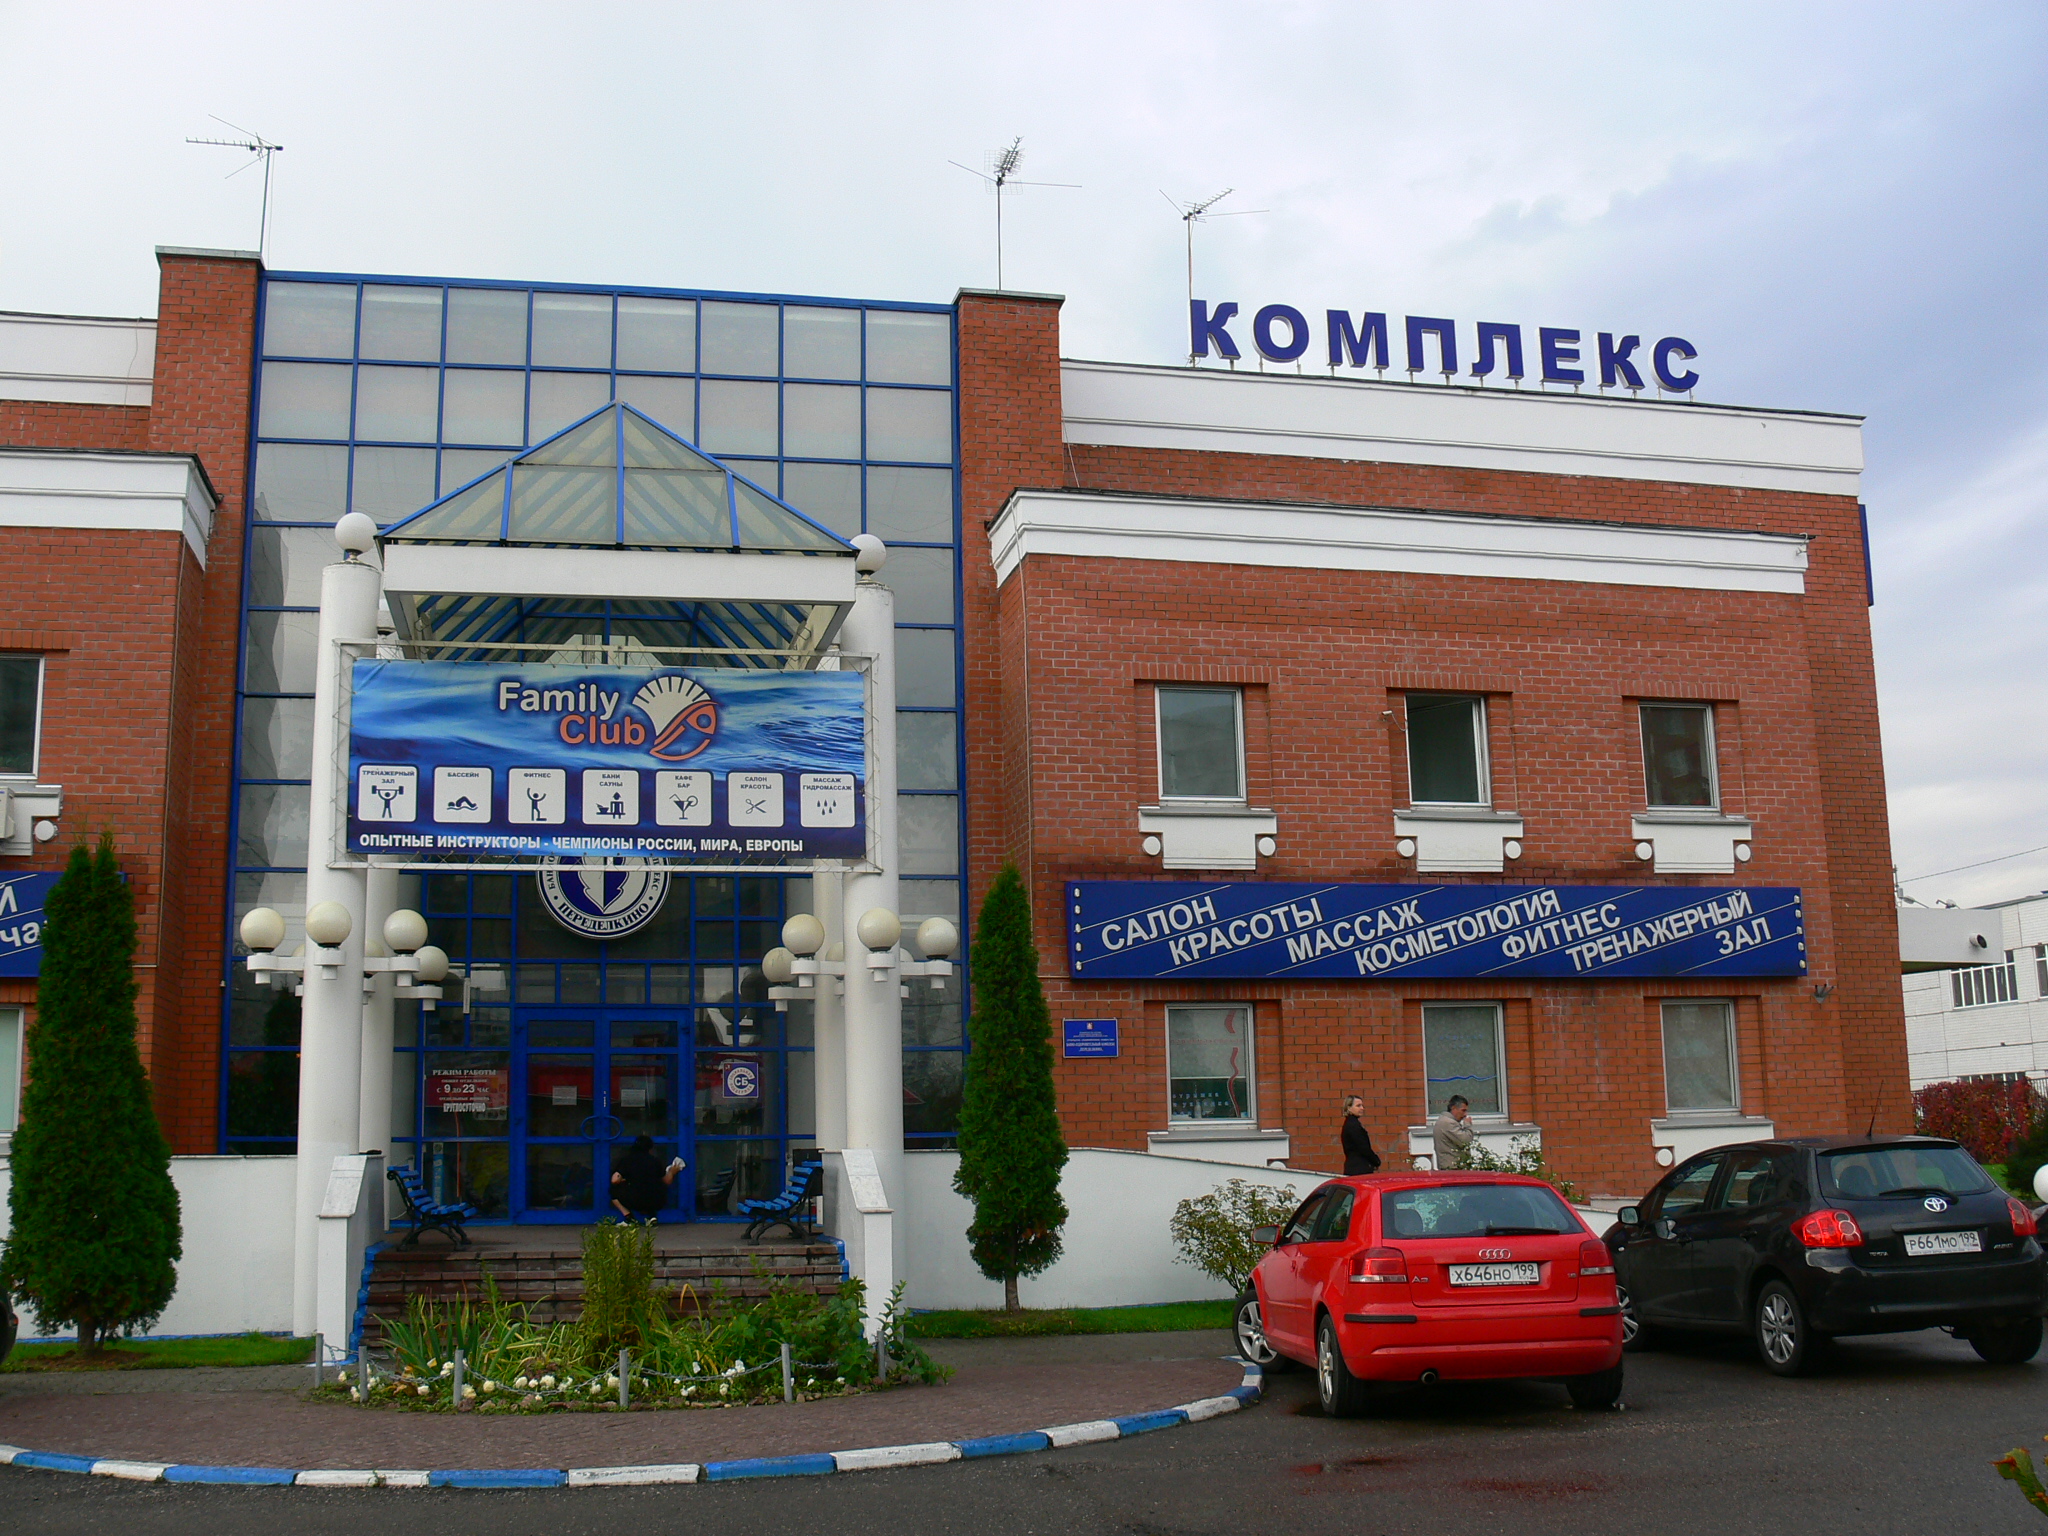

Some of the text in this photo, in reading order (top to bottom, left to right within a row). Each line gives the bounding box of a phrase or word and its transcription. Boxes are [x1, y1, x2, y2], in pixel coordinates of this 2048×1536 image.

[1189, 298, 1701, 393] КОМПЛЕКС
[499, 681, 620, 720] Family
[559, 714, 646, 745] Club
[362, 769, 415, 777] ТРЕНАЖЕРНЫЙ
[359, 834, 433, 848] ОПЫТНЫЕ
[437, 835, 541, 849] ИНСТРУКТОРЫ
[552, 837, 633, 850] ЧЕМПИОНЫ
[637, 838, 697, 853] РОССИИ,
[700, 838, 742, 853] МИРА,
[746, 840, 803, 852] ЕВРОПЫ
[558, 902, 649, 932] ПЕРЕДЕЛКИНО
[1101, 896, 1217, 950] САЛОН
[1168, 898, 1323, 966] КРАСОТЫ
[1285, 899, 1424, 963] МАССАЖ
[1354, 889, 1562, 975] КОСМЕТОЛОГИЯ
[1501, 903, 1621, 958] ФИТНЕС
[1565, 889, 1753, 971] ТРЕНАЖЕРНЫЙ
[1715, 917, 1771, 954] ЗАЛ
[444, 1083, 451, 1093] 9
[462, 1083, 476, 1093] 23
[734, 1077, 749, 1086] СБ
[443, 1102, 487, 1112] КРУГЛОСУТОЧНО
[1959, 1232, 1977, 1243] 199
[1514, 1264, 1534, 1276] 199
